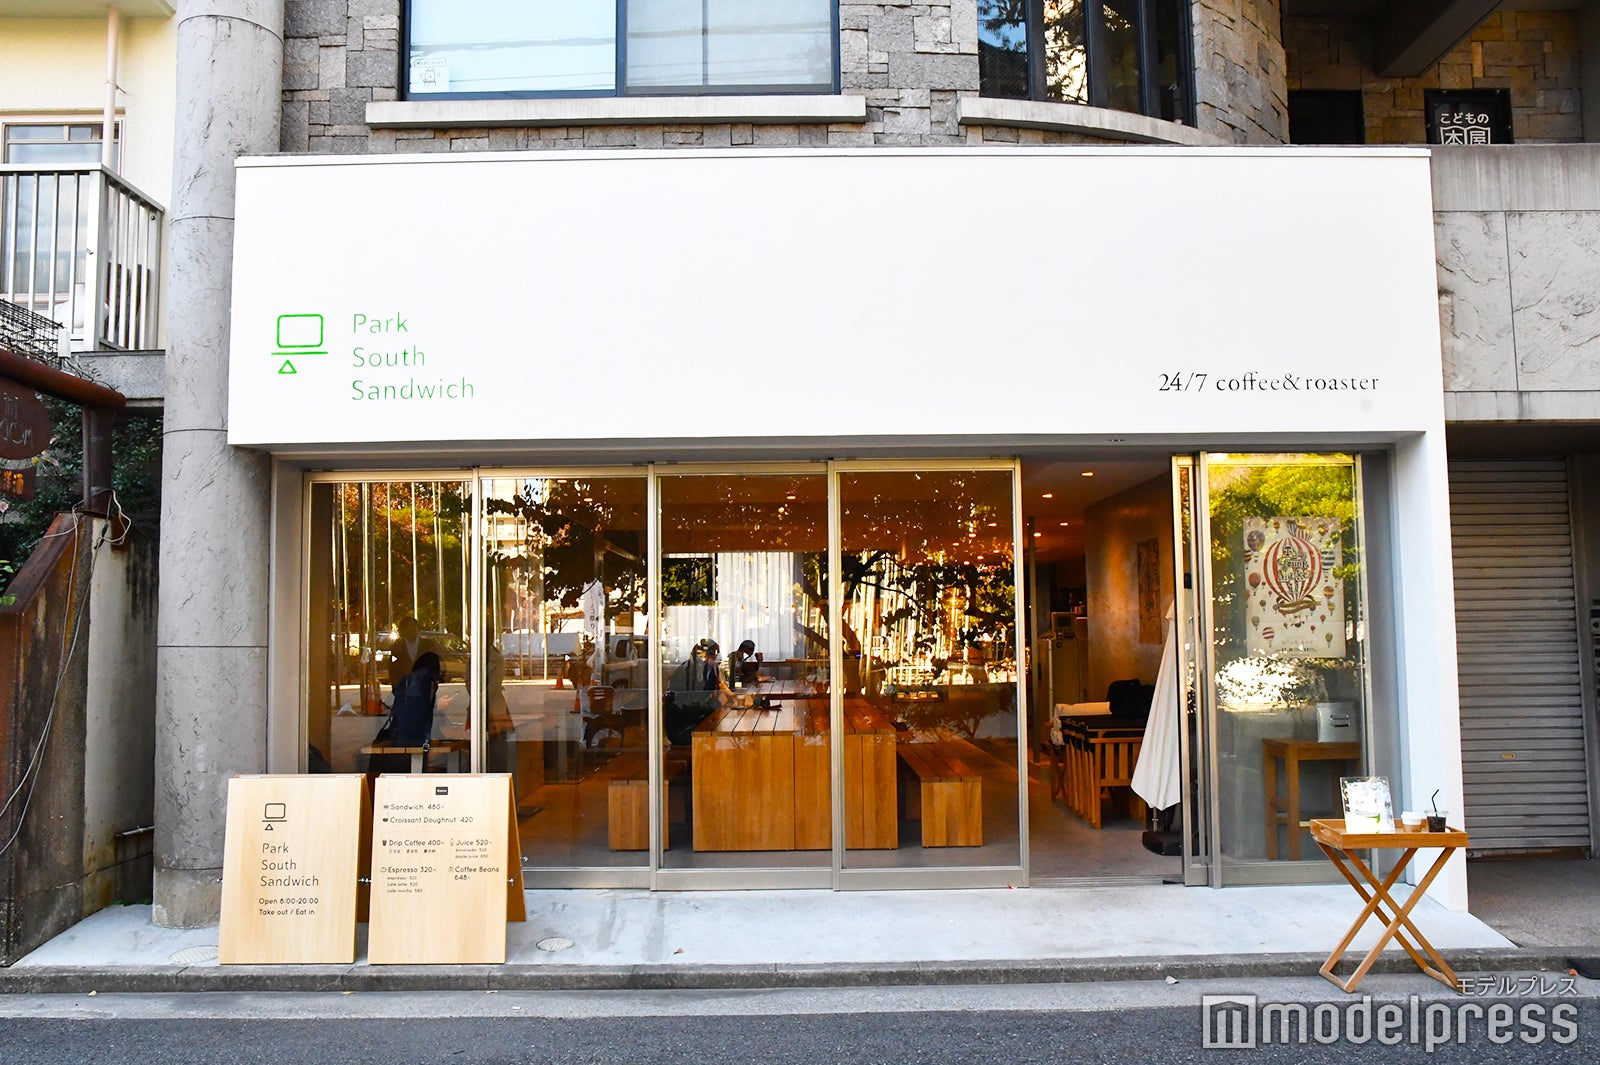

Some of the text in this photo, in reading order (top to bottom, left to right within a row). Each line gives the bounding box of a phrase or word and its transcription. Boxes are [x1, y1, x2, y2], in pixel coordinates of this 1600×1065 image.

[1440, 112, 1489, 125] こどもの
[353, 311, 408, 334] Park
[352, 345, 426, 368] South
[1158, 371, 1208, 393] 24/7
[351, 377, 475, 401] Sandwich
[389, 816, 422, 824] Croissant
[423, 816, 456, 825] Doughnut
[262, 842, 289, 854] Park
[388, 839, 403, 847] Drip
[261, 859, 297, 871] South
[387, 866, 418, 874] Espresso
[260, 875, 319, 887] Sandwich
[258, 897, 278, 905] Open
[259, 908, 275, 916] Take
[276, 908, 288, 916] out
[295, 908, 307, 916] Eat
